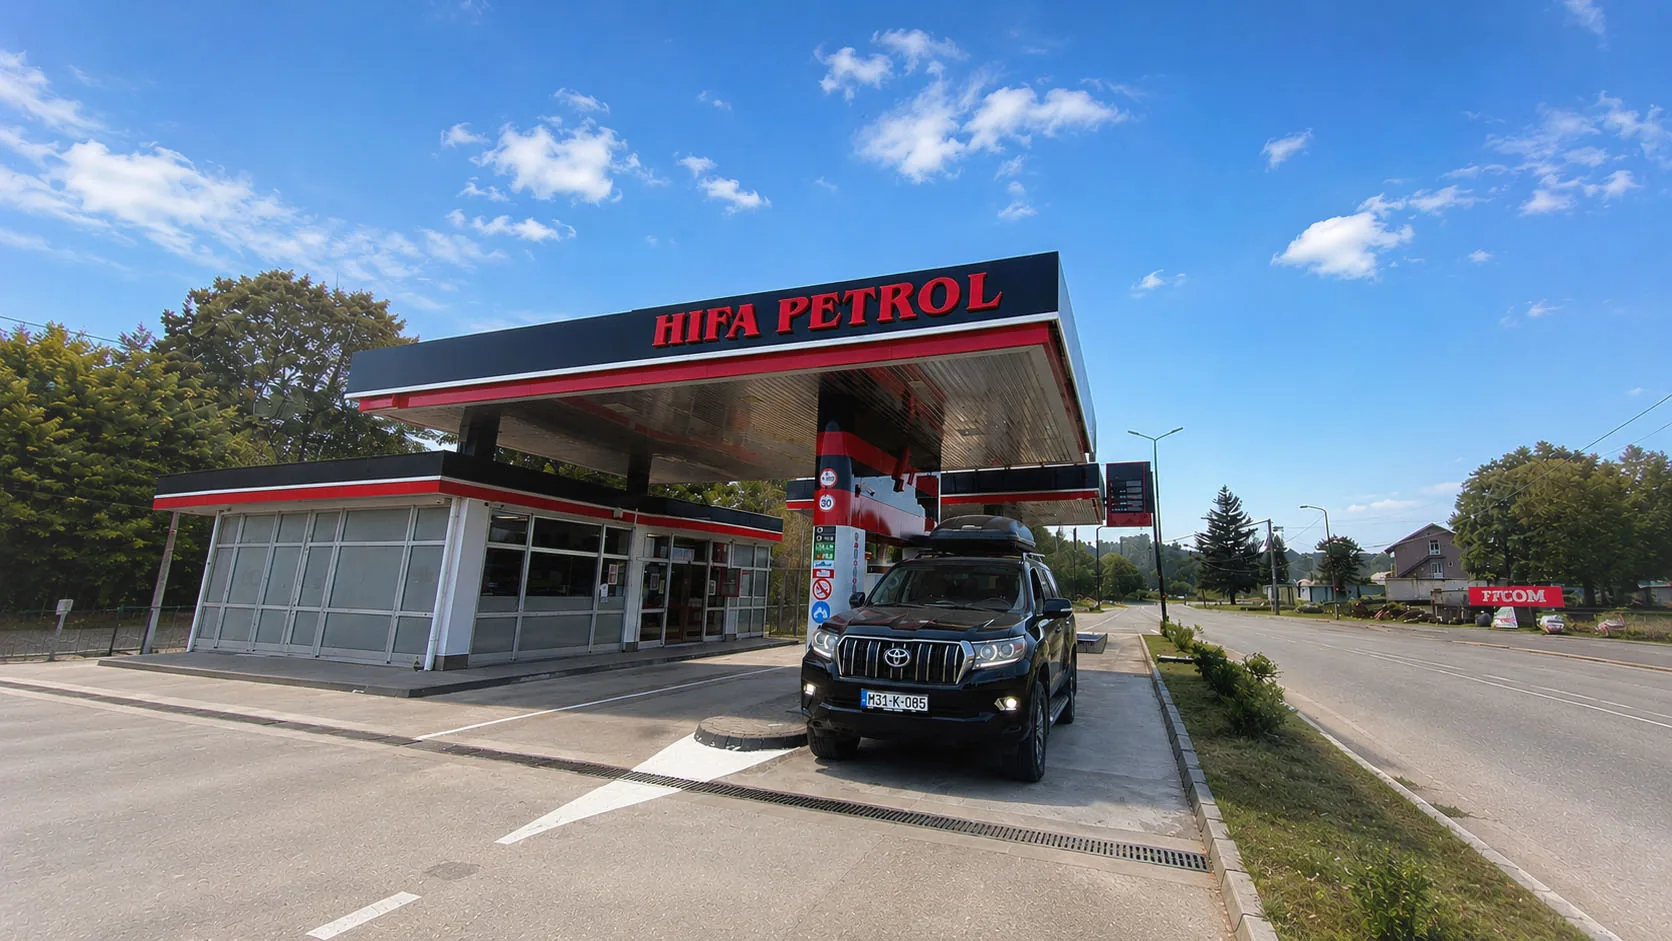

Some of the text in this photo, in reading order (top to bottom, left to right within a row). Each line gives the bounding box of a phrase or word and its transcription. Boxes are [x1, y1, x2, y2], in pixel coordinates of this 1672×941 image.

[652, 272, 1003, 347] HIFA PETROL
[821, 499, 831, 507] 30
